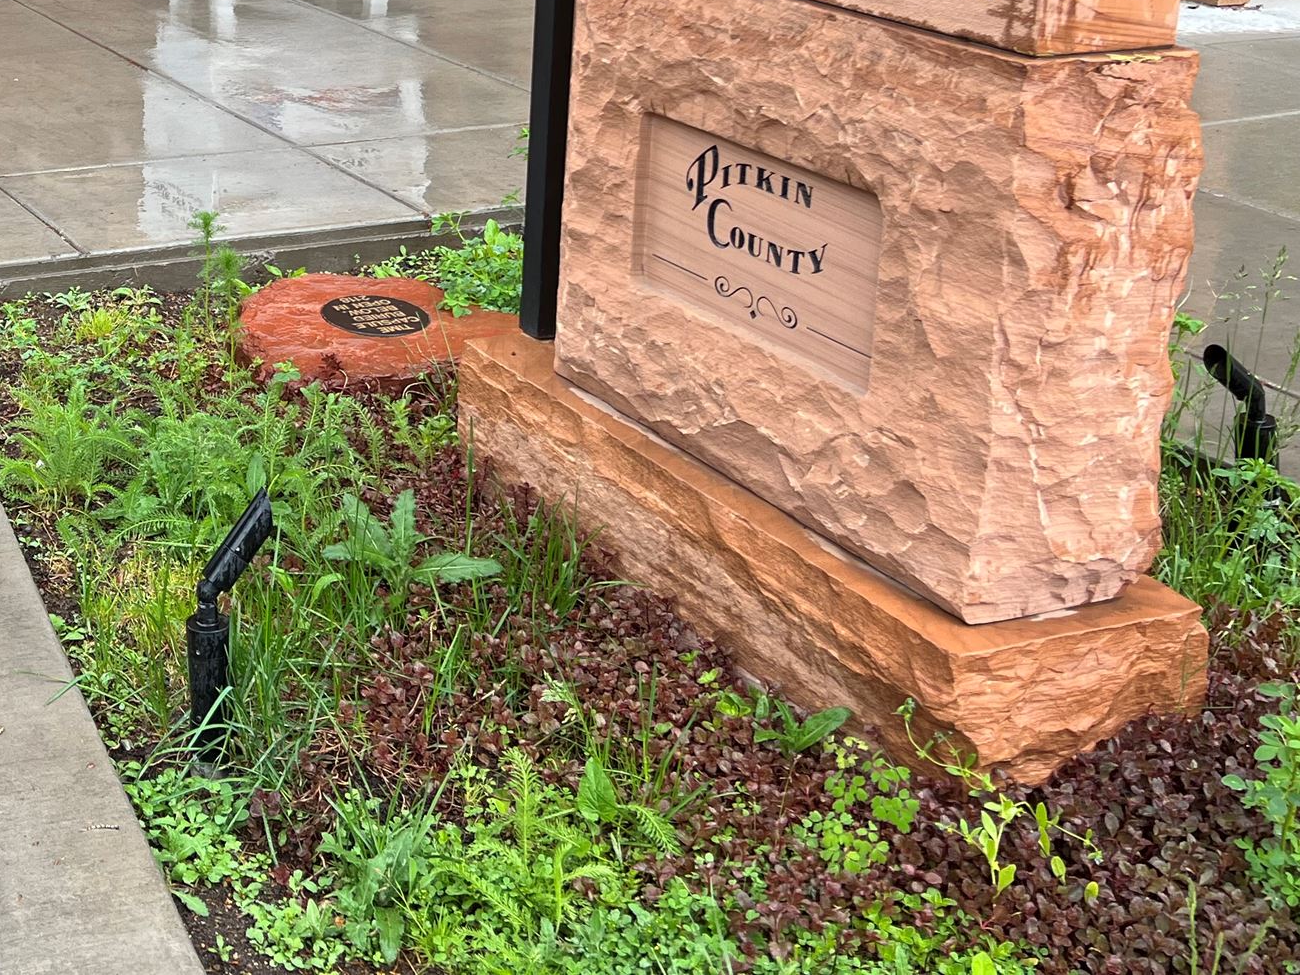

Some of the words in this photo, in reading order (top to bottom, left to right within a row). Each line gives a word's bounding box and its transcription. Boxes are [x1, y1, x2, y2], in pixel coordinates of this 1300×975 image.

[686, 144, 814, 211] PITKIN
[707, 198, 829, 275] COUNTY
[332, 304, 350, 312] IN
[352, 299, 391, 309] OPEN
[353, 310, 407, 322] BURIED
[352, 316, 420, 330] CAPSULE
[377, 324, 415, 334] TIME
